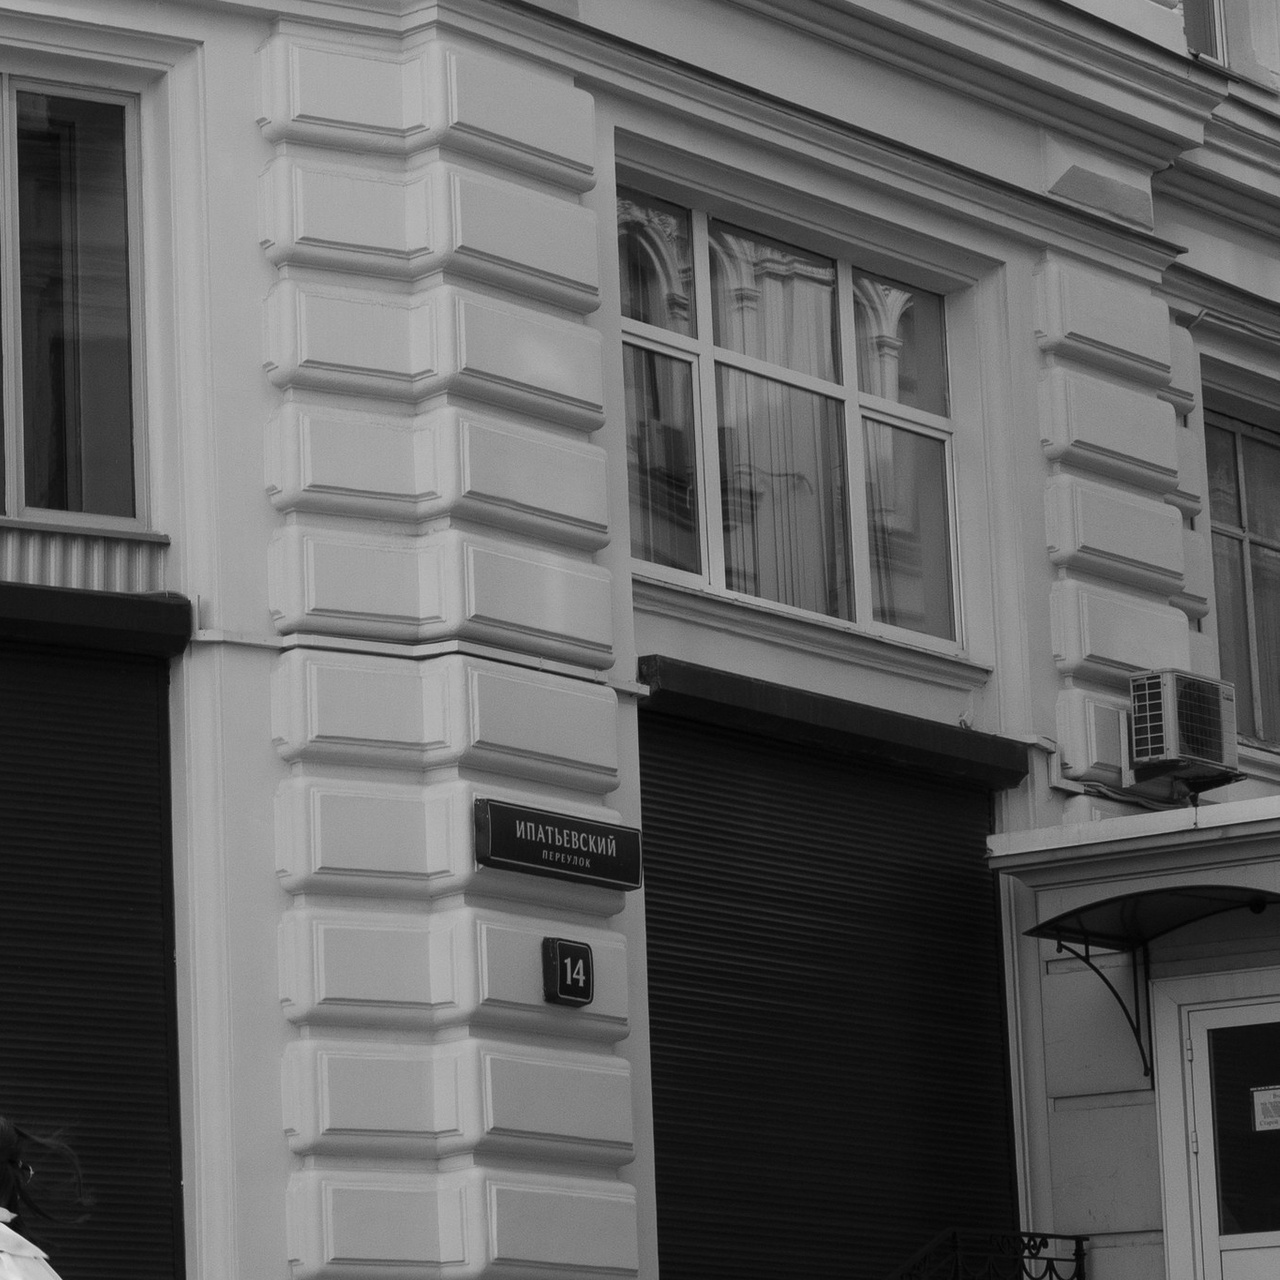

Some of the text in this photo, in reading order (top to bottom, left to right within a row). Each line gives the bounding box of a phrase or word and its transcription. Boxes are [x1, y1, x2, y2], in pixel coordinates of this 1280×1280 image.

[516, 820, 616, 857] ИПАТЬЕВСКИЙ
[542, 849, 591, 868] ПЕРЕУЛОК
[564, 957, 585, 987] 14
